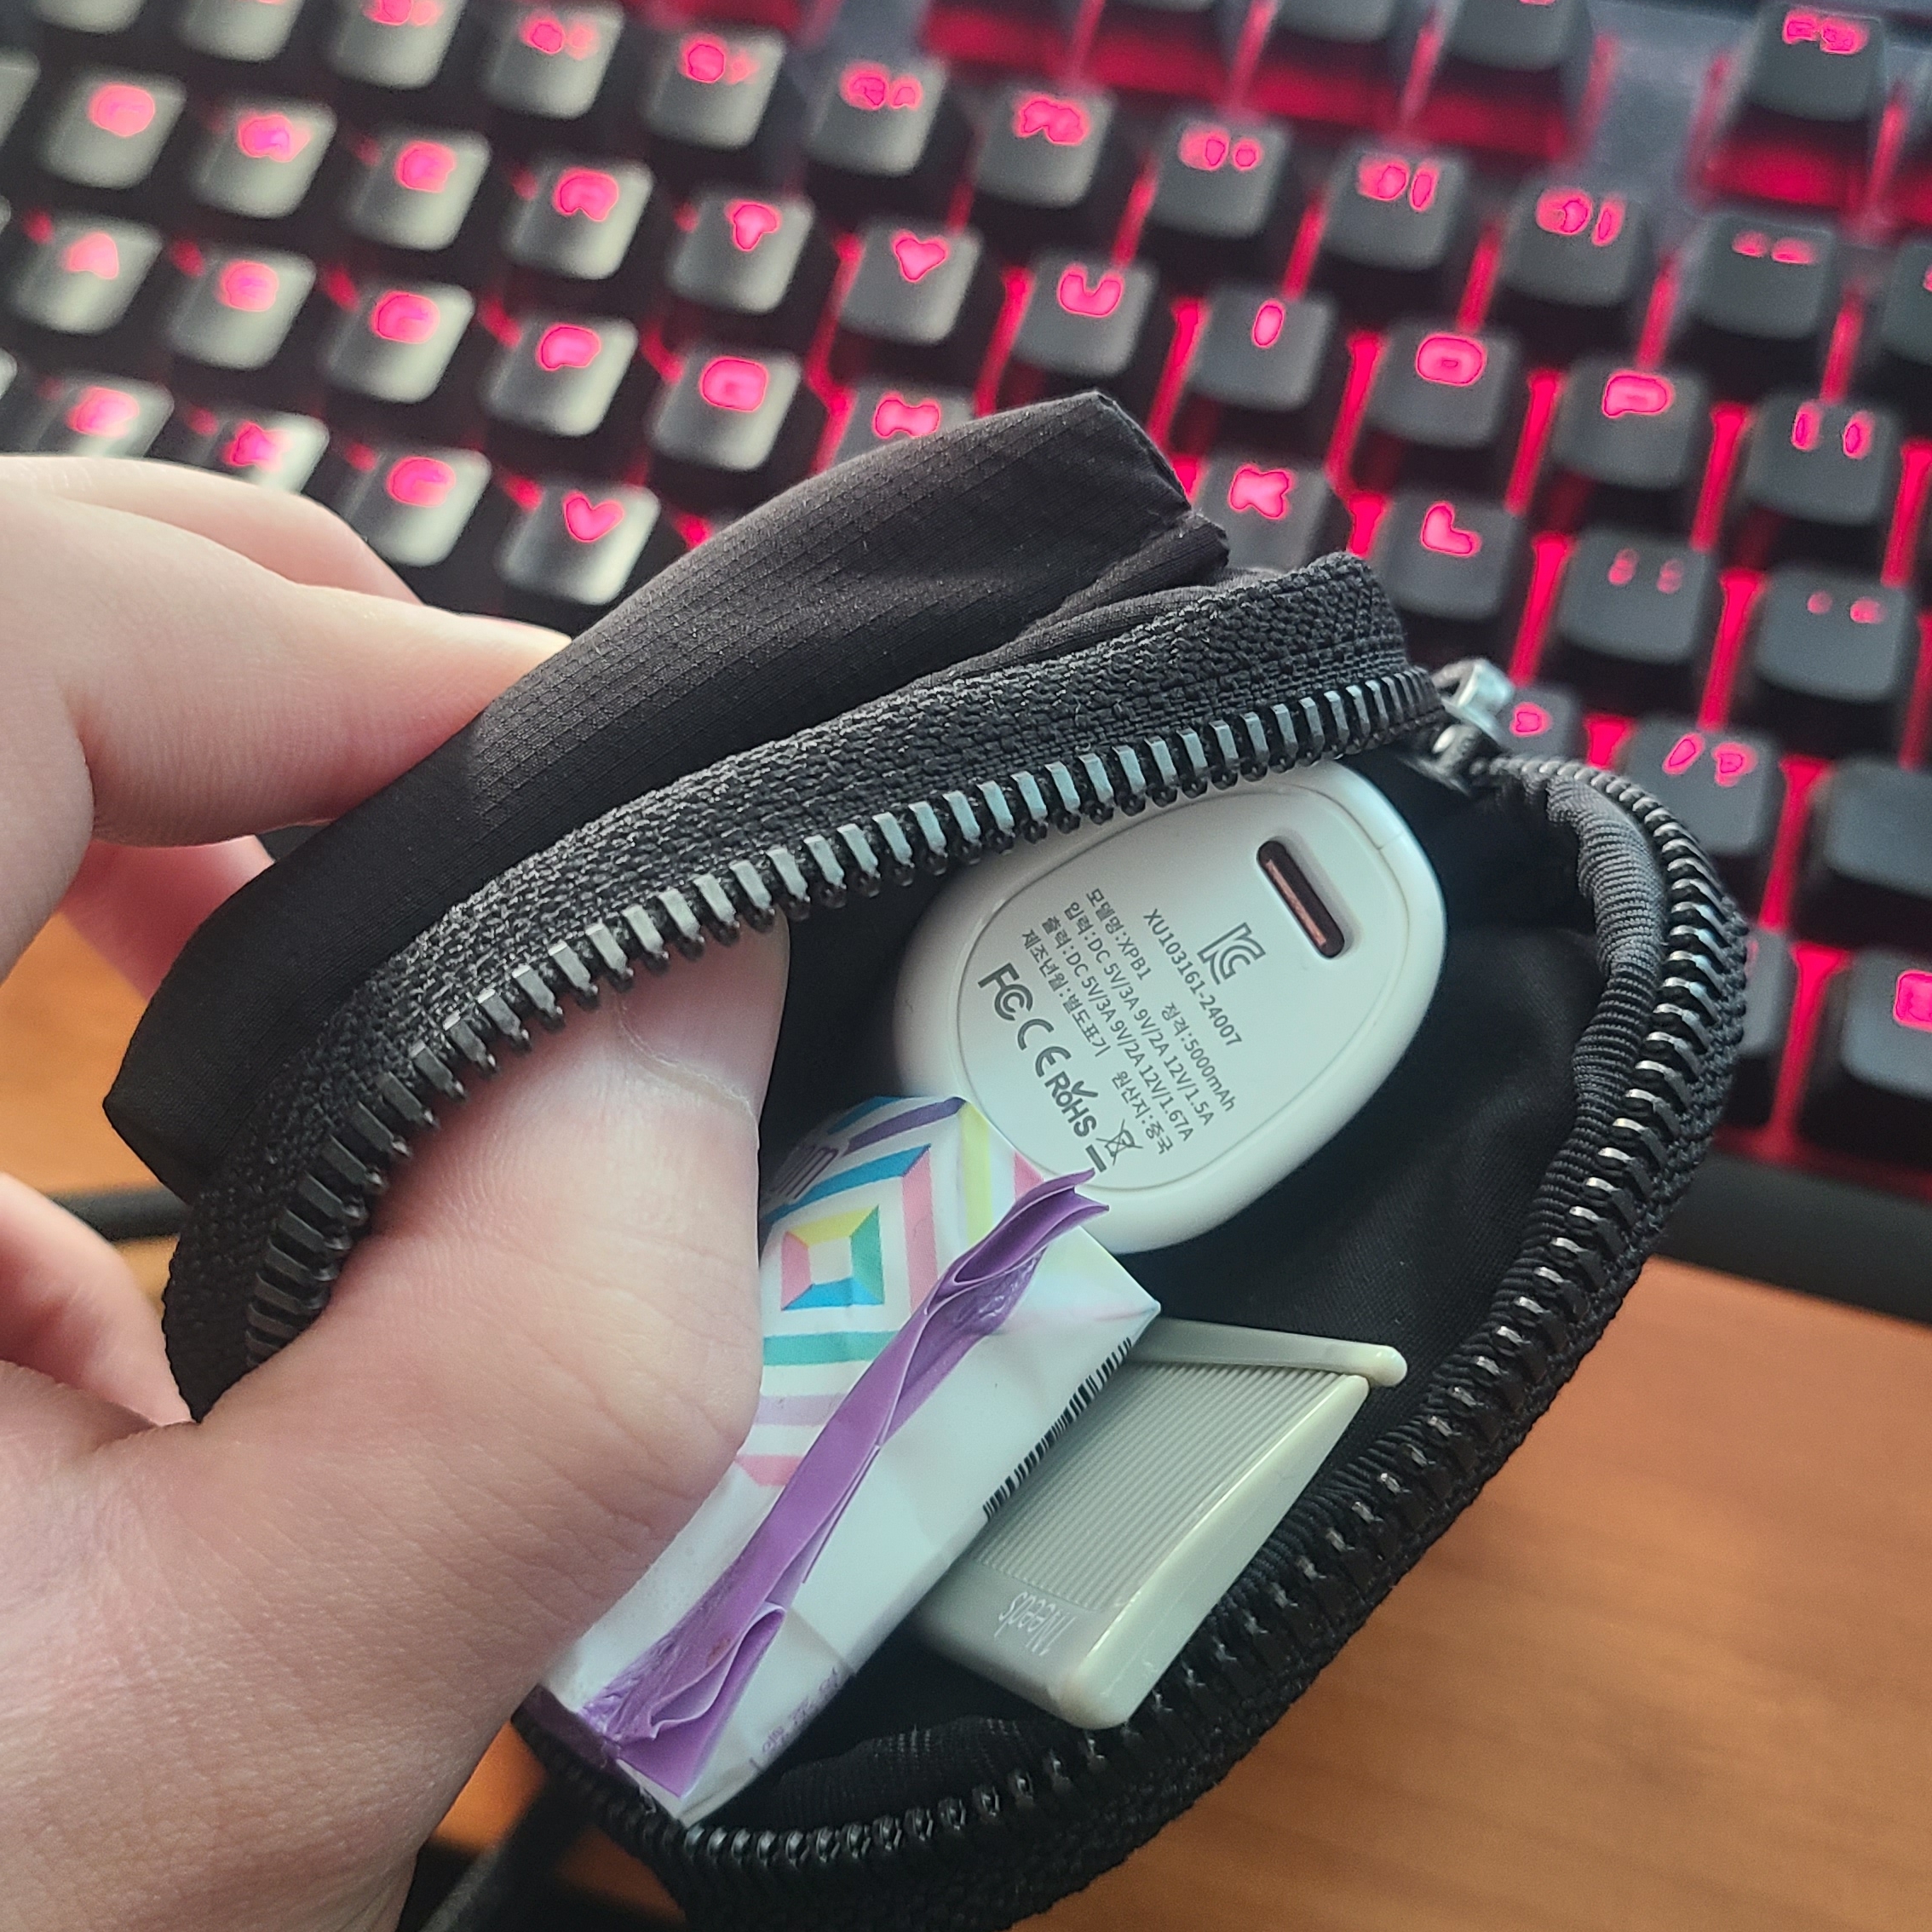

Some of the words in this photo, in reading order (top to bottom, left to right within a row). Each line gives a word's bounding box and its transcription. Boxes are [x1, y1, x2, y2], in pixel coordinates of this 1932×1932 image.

[977, 962, 1032, 1021] FCC
[1021, 929, 1111, 1056] 제조년월:별도표기
[1085, 888, 1151, 980] 모델명:XPB1
[1143, 908, 1241, 1045] XU103161-24007
[1041, 916, 1089, 977] 출력:DC
[1081, 975, 1116, 1022] 5V/3A
[1109, 1020, 1145, 1067] 9V/2A
[1138, 1064, 1193, 1141] 12V/1.67A
[1063, 901, 1110, 963] 입력:DC
[1103, 963, 1139, 1010] 5V/3A
[1133, 1009, 1169, 1056] 9V/2A
[1163, 1055, 1214, 1125] 12V/1.5A
[1161, 1002, 1234, 1111] 정격:5000mAh
[1111, 1071, 1173, 1153] 원산지:중국
